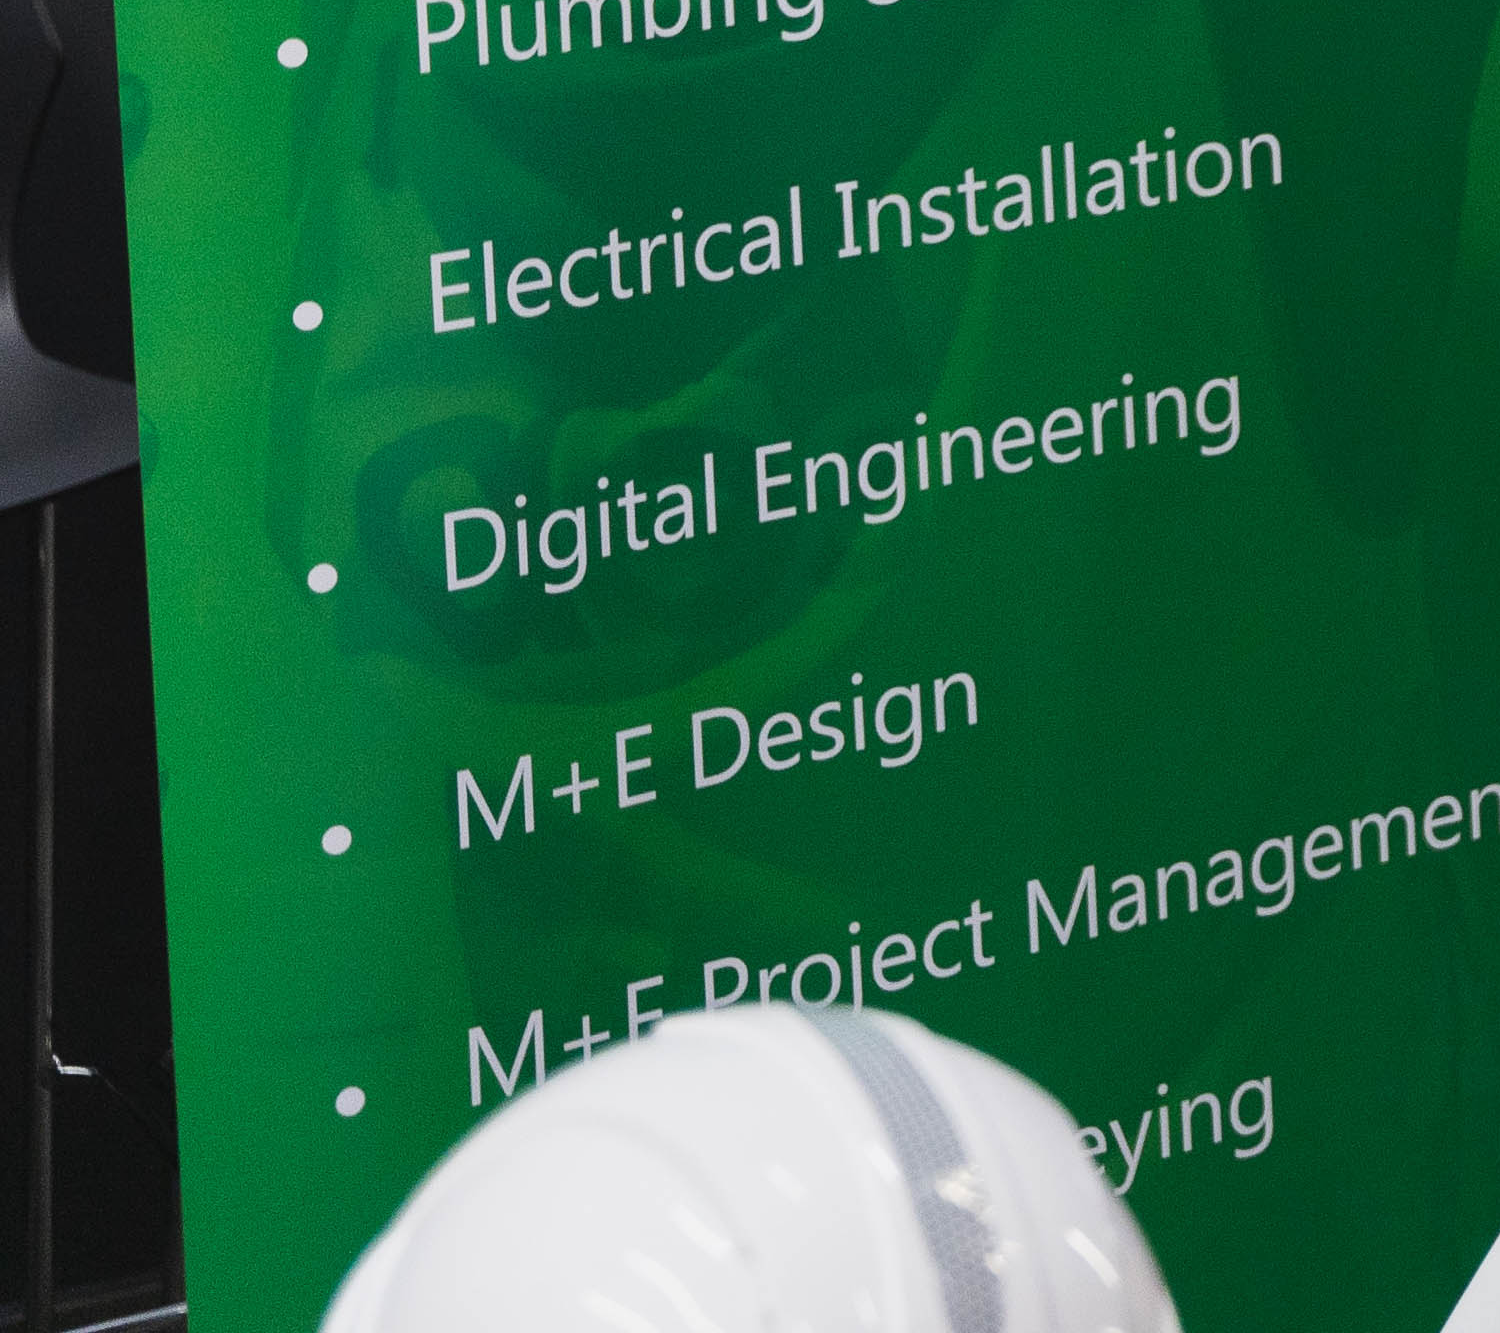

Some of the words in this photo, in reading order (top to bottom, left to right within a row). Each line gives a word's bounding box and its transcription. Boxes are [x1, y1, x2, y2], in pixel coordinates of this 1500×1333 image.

[430, 186, 803, 333] Electrical
[836, 127, 1281, 258] Installation
[444, 453, 716, 593] Digital
[756, 374, 1240, 524] Engineering
[457, 724, 656, 849] M+E
[692, 673, 977, 788] Design
[703, 900, 994, 1013] Project
